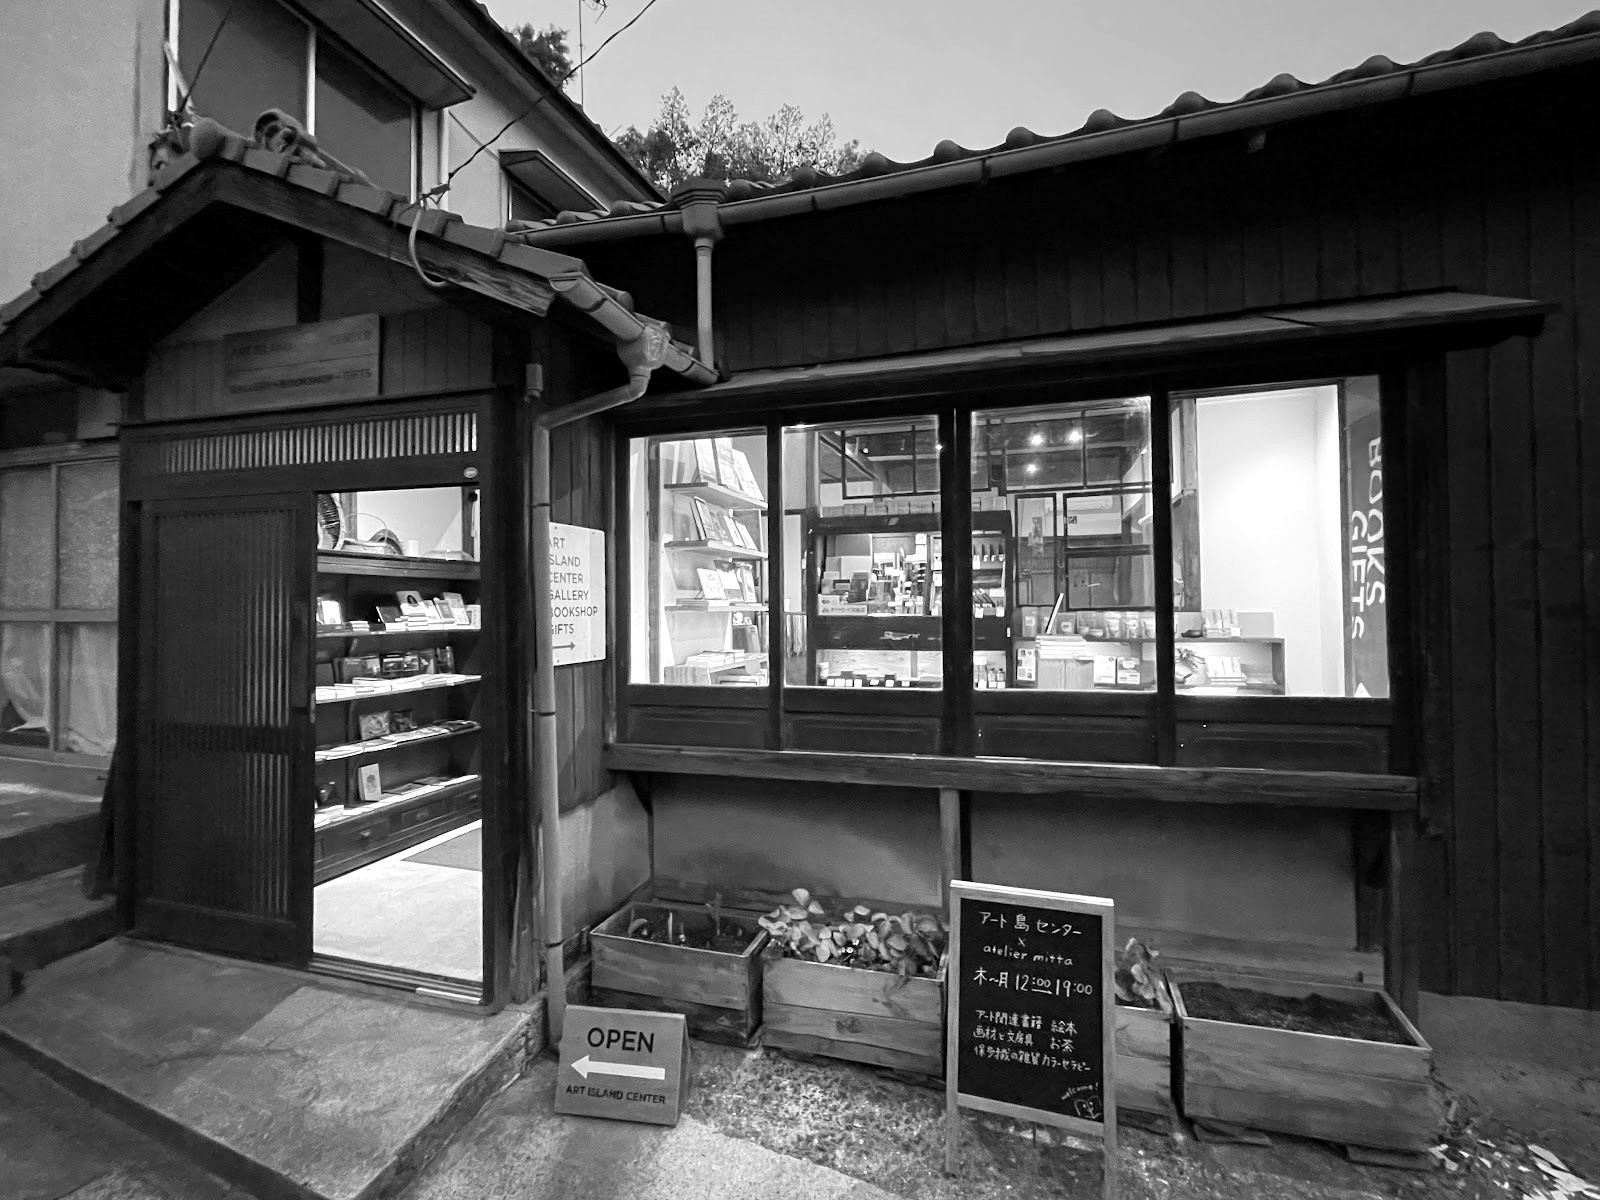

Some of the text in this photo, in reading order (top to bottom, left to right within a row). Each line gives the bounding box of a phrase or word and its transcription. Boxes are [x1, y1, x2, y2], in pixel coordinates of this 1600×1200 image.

[1367, 437, 1385, 606] BOOKS
[549, 554, 581, 567] SLAND
[1352, 511, 1367, 639] GIFTS
[1037, 920, 1081, 936] センター
[983, 945, 1073, 965] atelier mitta
[1050, 1020, 1078, 1036] 絵本
[587, 1027, 654, 1053] OPEN
[1050, 1037, 1075, 1052] お茶
[1042, 1054, 1091, 1072] カラーセラピー
[566, 1085, 666, 1104] ART ISLAND CENTER
